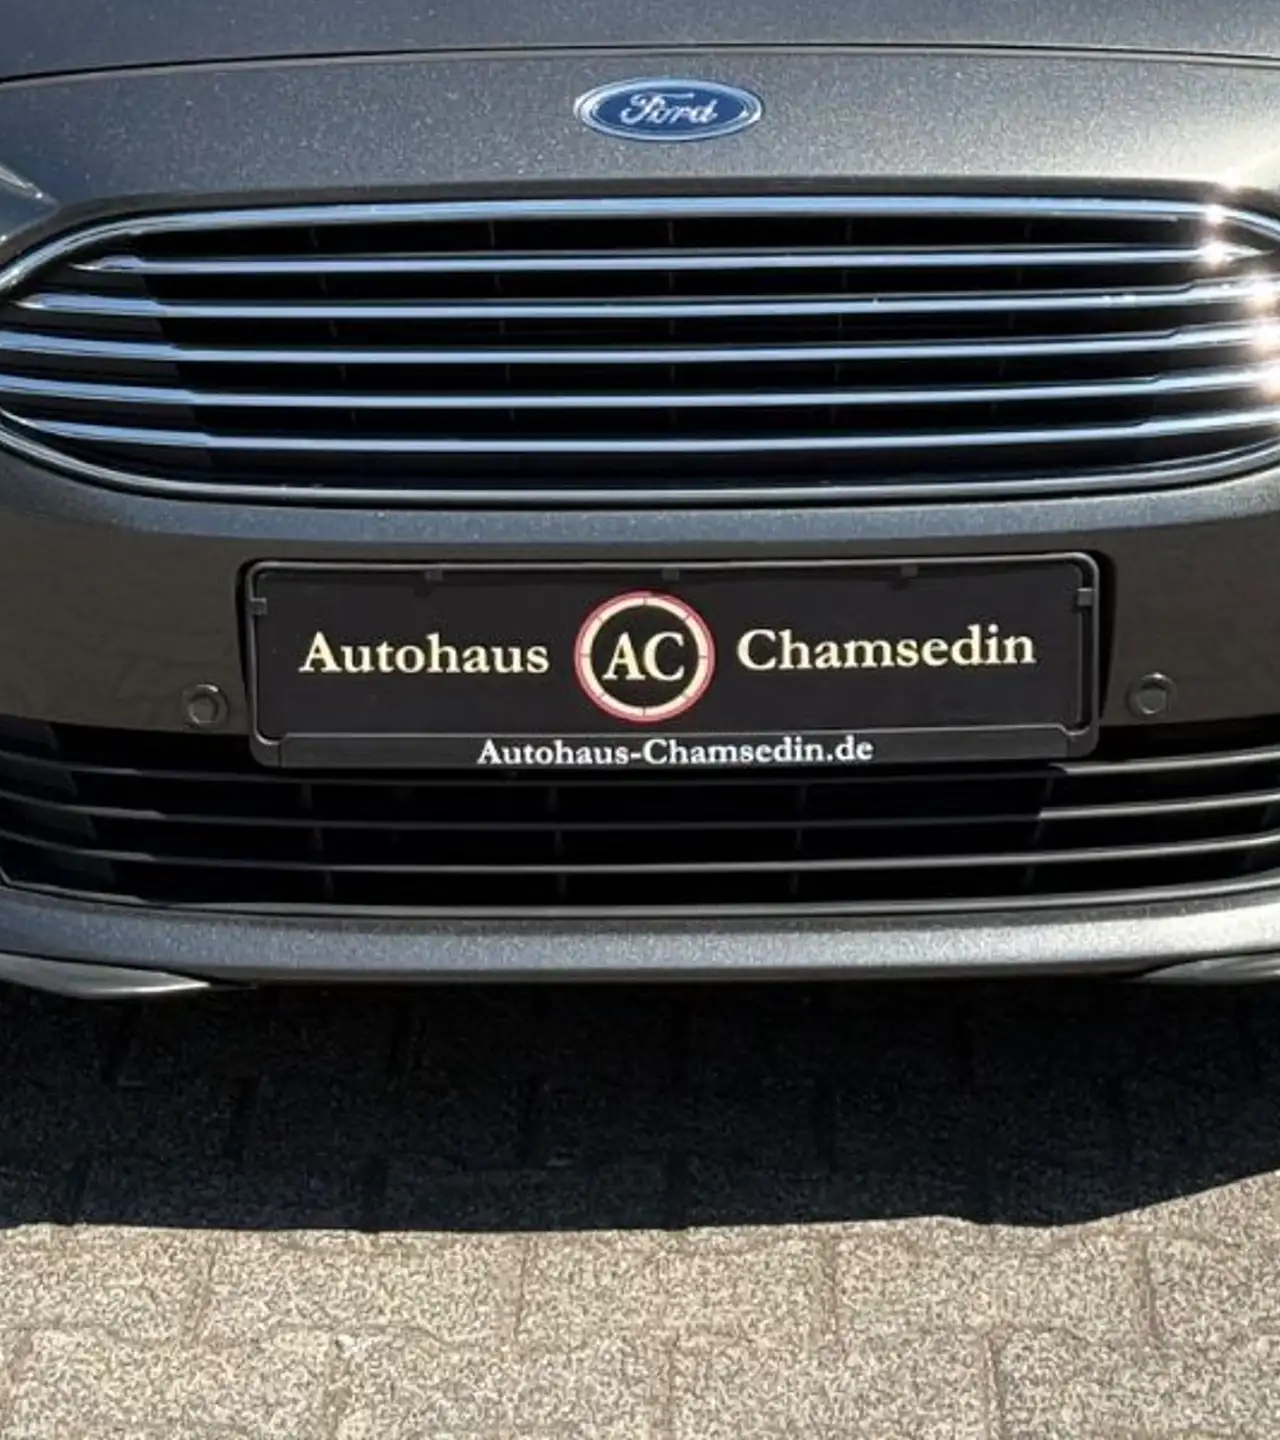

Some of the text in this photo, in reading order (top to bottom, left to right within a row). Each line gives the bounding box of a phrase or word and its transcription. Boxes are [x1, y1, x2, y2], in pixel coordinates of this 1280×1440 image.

[619, 91, 718, 126] Ford
[298, 623, 1037, 682] Autohaus AC Chamsedin
[477, 735, 874, 768] Autohaus-Chamsedin.de
